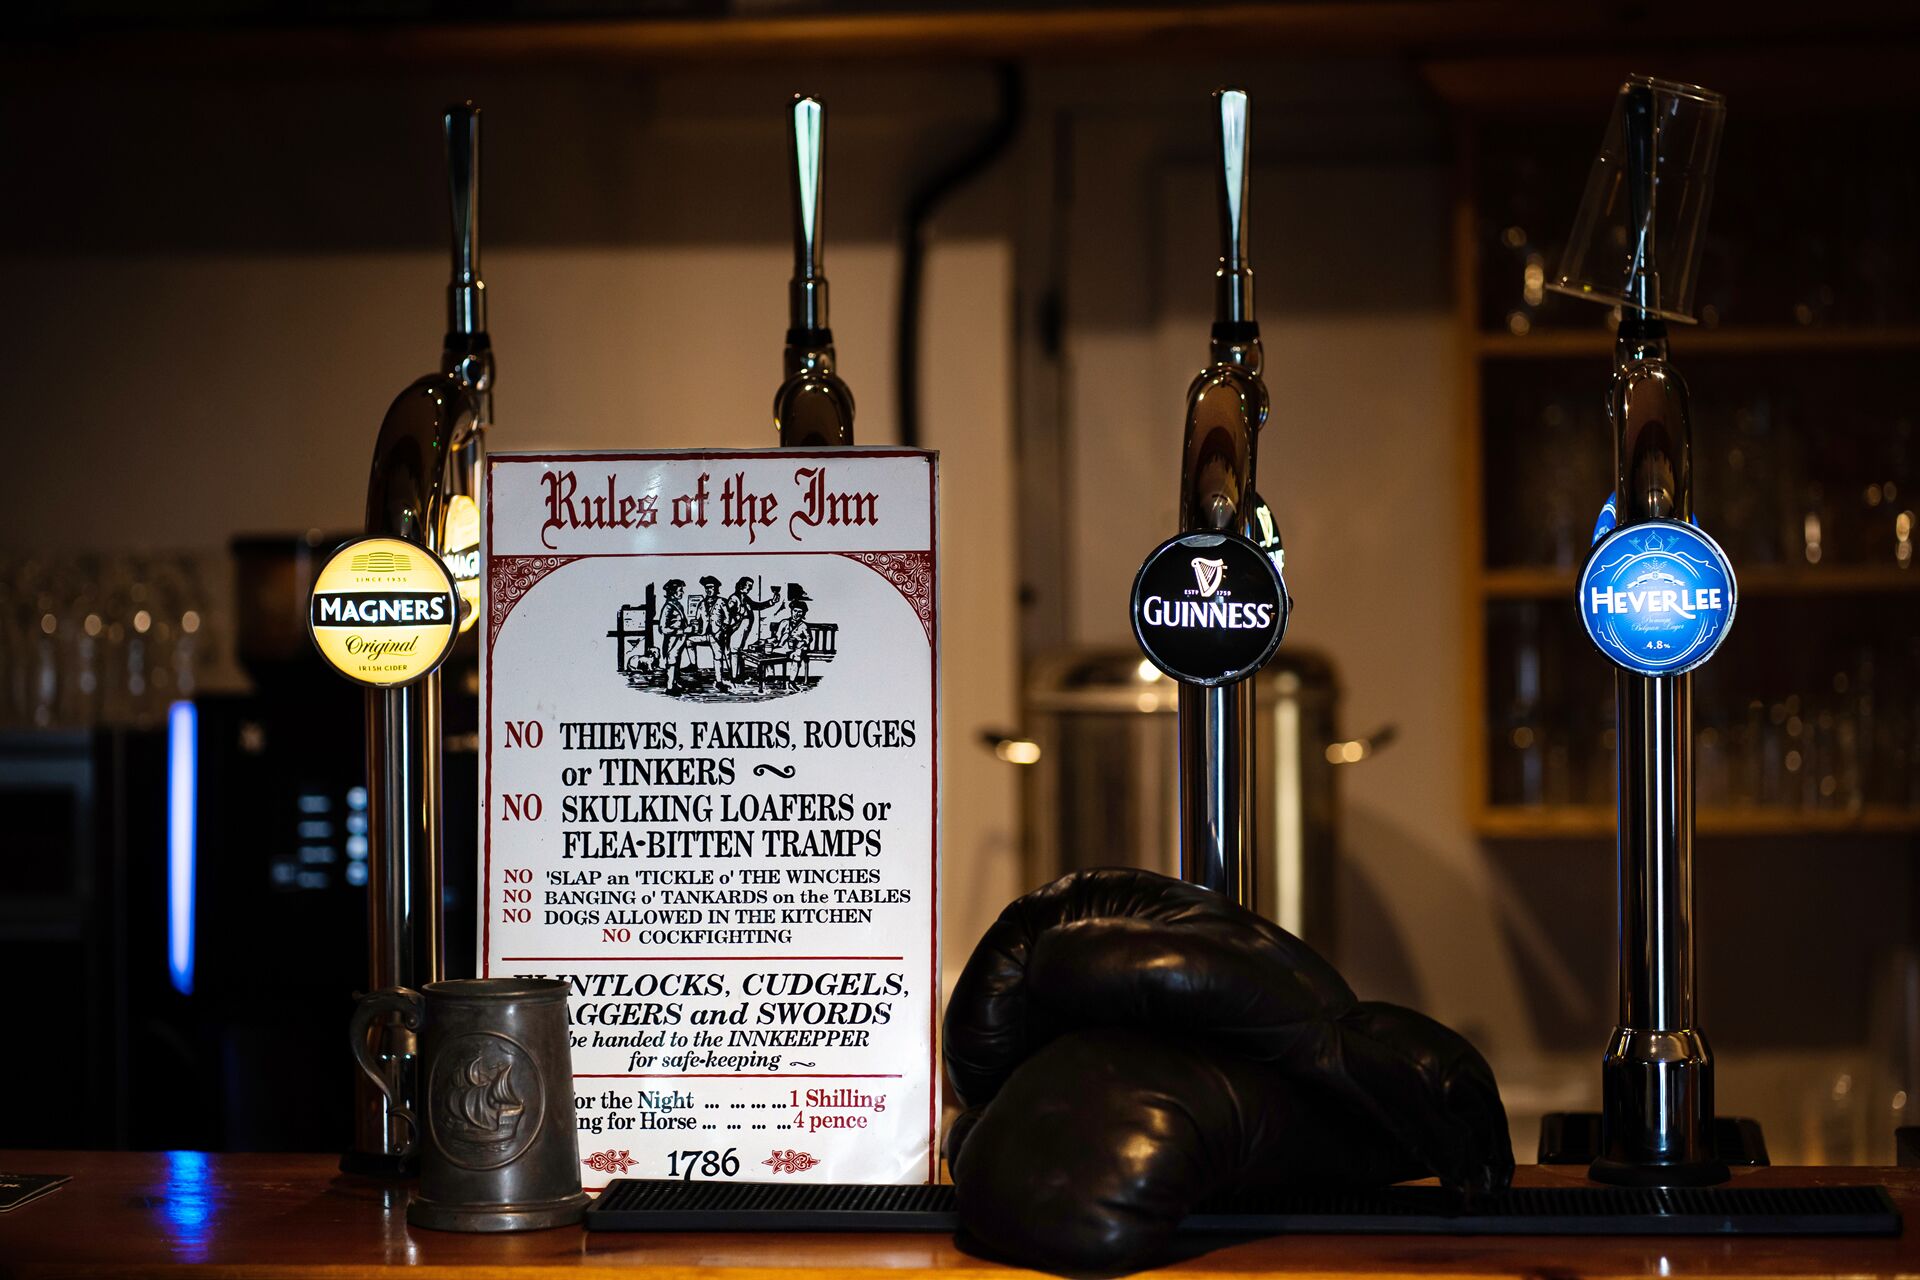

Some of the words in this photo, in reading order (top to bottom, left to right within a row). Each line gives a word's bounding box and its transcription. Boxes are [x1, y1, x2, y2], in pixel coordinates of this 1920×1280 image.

[541, 471, 658, 549] Rules
[671, 472, 710, 528] of
[720, 472, 778, 544] the
[789, 467, 879, 541] Inn
[320, 597, 445, 623] MAGNERS
[1143, 596, 1273, 628] GUINNESS
[1591, 585, 1722, 619] HEVERLEE
[345, 634, 419, 660] Original
[1646, 640, 1671, 649] 4.8%
[505, 721, 543, 748] NO
[560, 722, 683, 751] THIEVES,
[691, 721, 796, 751] FAKIRS,
[804, 720, 915, 748] ROUGES
[562, 768, 592, 786] or
[600, 758, 735, 785] TINKERS
[502, 794, 542, 821] NO
[562, 795, 712, 822] SKULKING
[721, 794, 854, 822] LOAFERS
[863, 803, 891, 821] or
[762, 830, 881, 857] TRAMPS
[504, 869, 532, 883] NO
[547, 871, 601, 885] 'SLAP
[608, 875, 629, 885] an
[636, 870, 713, 884] 'TICKLE
[739, 870, 780, 884] THE
[786, 869, 880, 883] WINCHES
[504, 889, 531, 903] NO
[545, 891, 636, 904] BANGING
[661, 890, 767, 904] TANKARDS
[773, 894, 794, 903] on
[800, 890, 828, 903] the
[834, 889, 910, 903] TABLES
[503, 909, 531, 923] NO
[544, 910, 599, 925] DOGS
[605, 910, 701, 925] ALLOWED
[708, 910, 730, 924] IN
[735, 909, 775, 923] THE
[781, 909, 872, 923] KITCHEN
[603, 929, 630, 942] NO
[639, 930, 792, 944] COCKFIGHTING
[513, 974, 730, 999] NTLOCKS,
[743, 973, 908, 997] CUDGELS,
[690, 1002, 748, 1025] and
[757, 1002, 892, 1024] SWORDS
[592, 1031, 664, 1048] handed
[671, 1032, 688, 1047] to
[694, 1031, 723, 1047] the
[728, 1030, 869, 1046] INNKEEPPER
[628, 1051, 657, 1072] for
[662, 1051, 781, 1072] safe-keeping
[575, 1092, 596, 1109] or
[601, 1091, 632, 1109] the
[638, 1091, 695, 1114] Night
[806, 1089, 886, 1112] Shilling
[607, 1111, 636, 1129] for
[640, 1111, 697, 1130] Horse
[810, 1116, 867, 1132] pence
[667, 1148, 739, 1180] 1786
